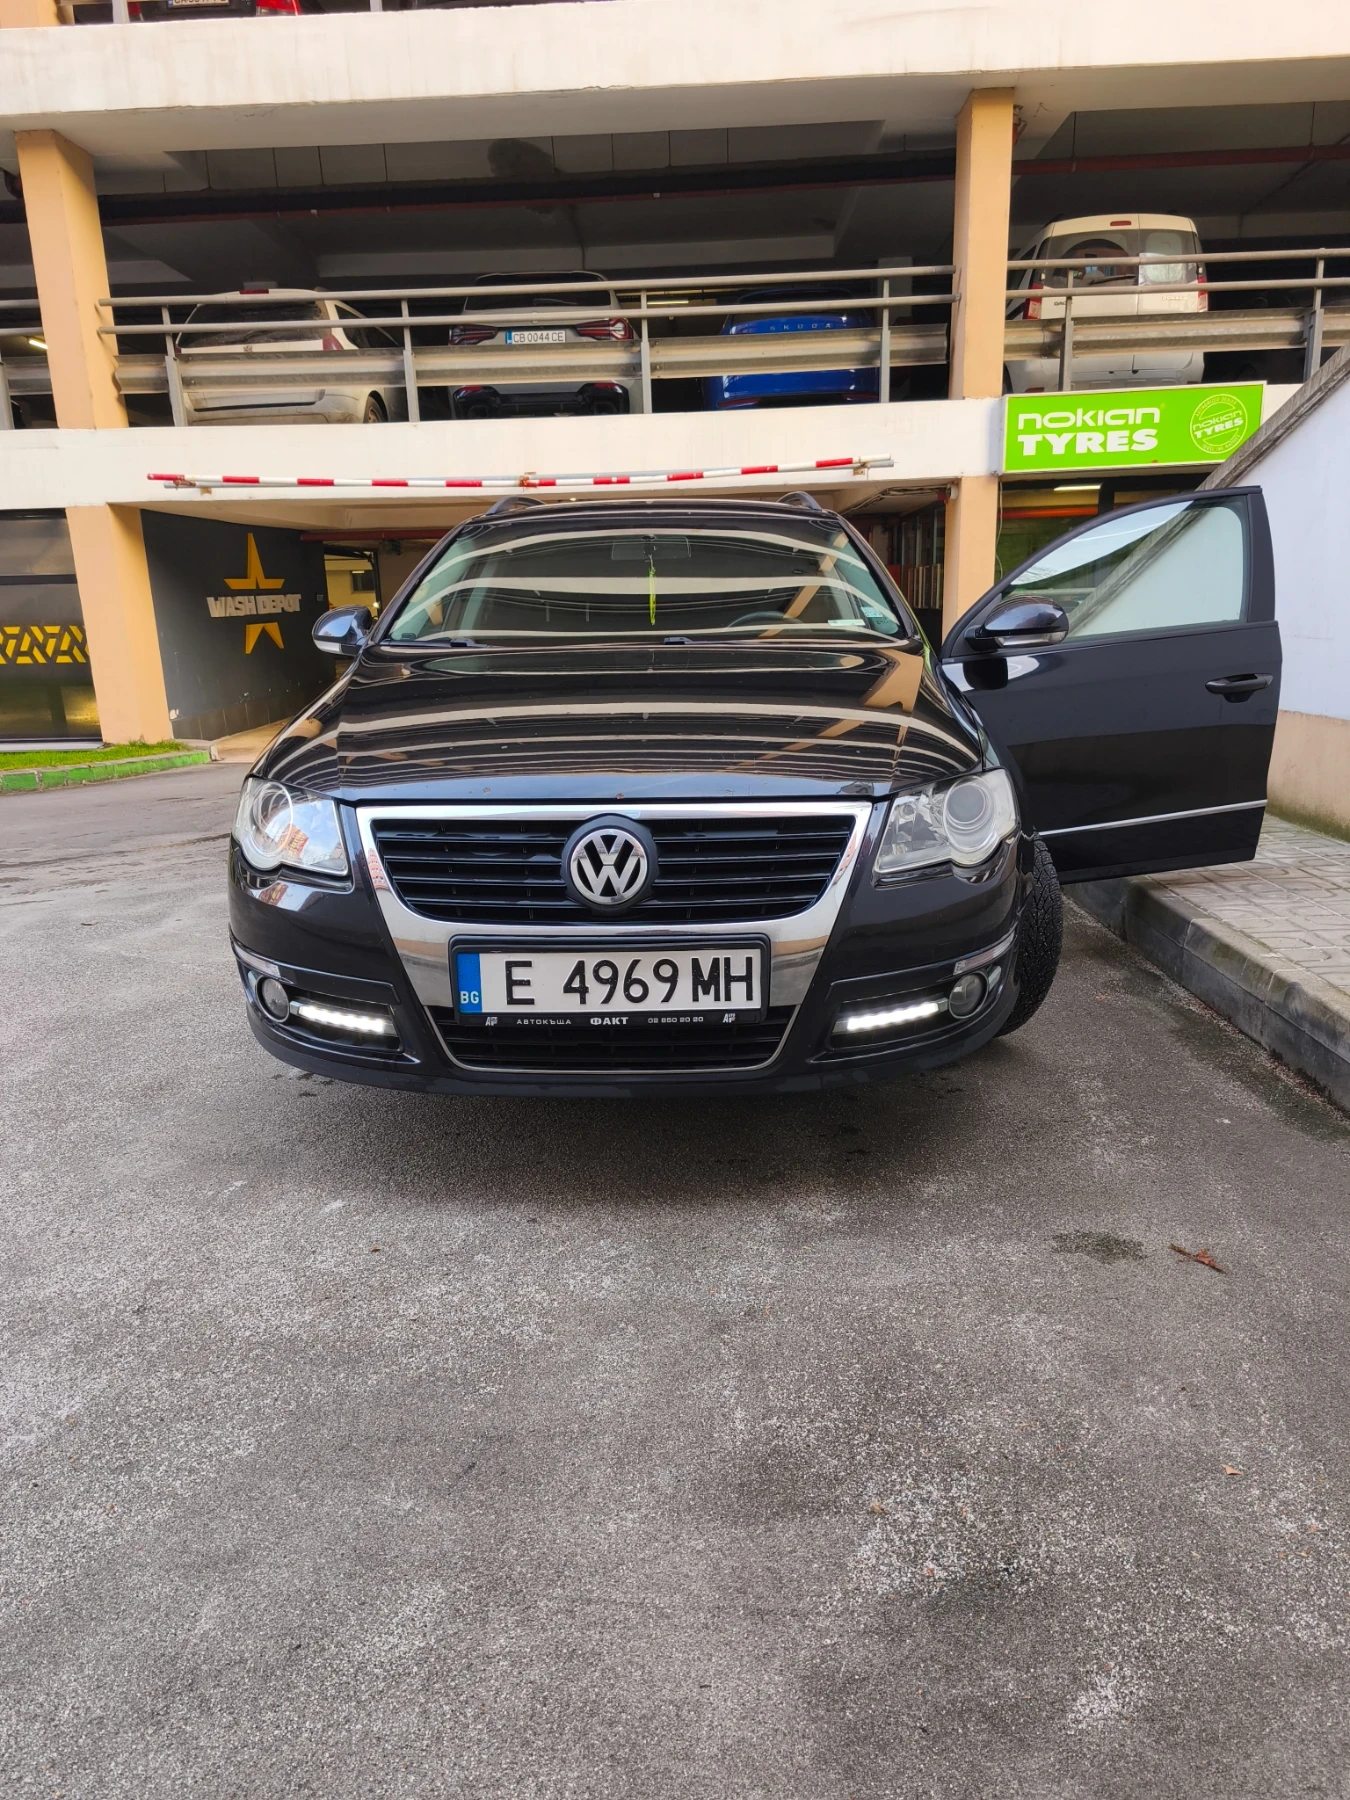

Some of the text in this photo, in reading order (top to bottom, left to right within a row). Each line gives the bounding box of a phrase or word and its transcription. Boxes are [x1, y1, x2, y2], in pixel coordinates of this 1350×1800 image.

[513, 331, 564, 343] CB 0044 CE
[1193, 417, 1244, 439] TYRES
[1017, 428, 1159, 456] TYRES
[206, 593, 302, 618] WASH DEPOT
[459, 955, 755, 1006] BG E 4969 MH
[589, 1016, 629, 1026] ФАКТ
